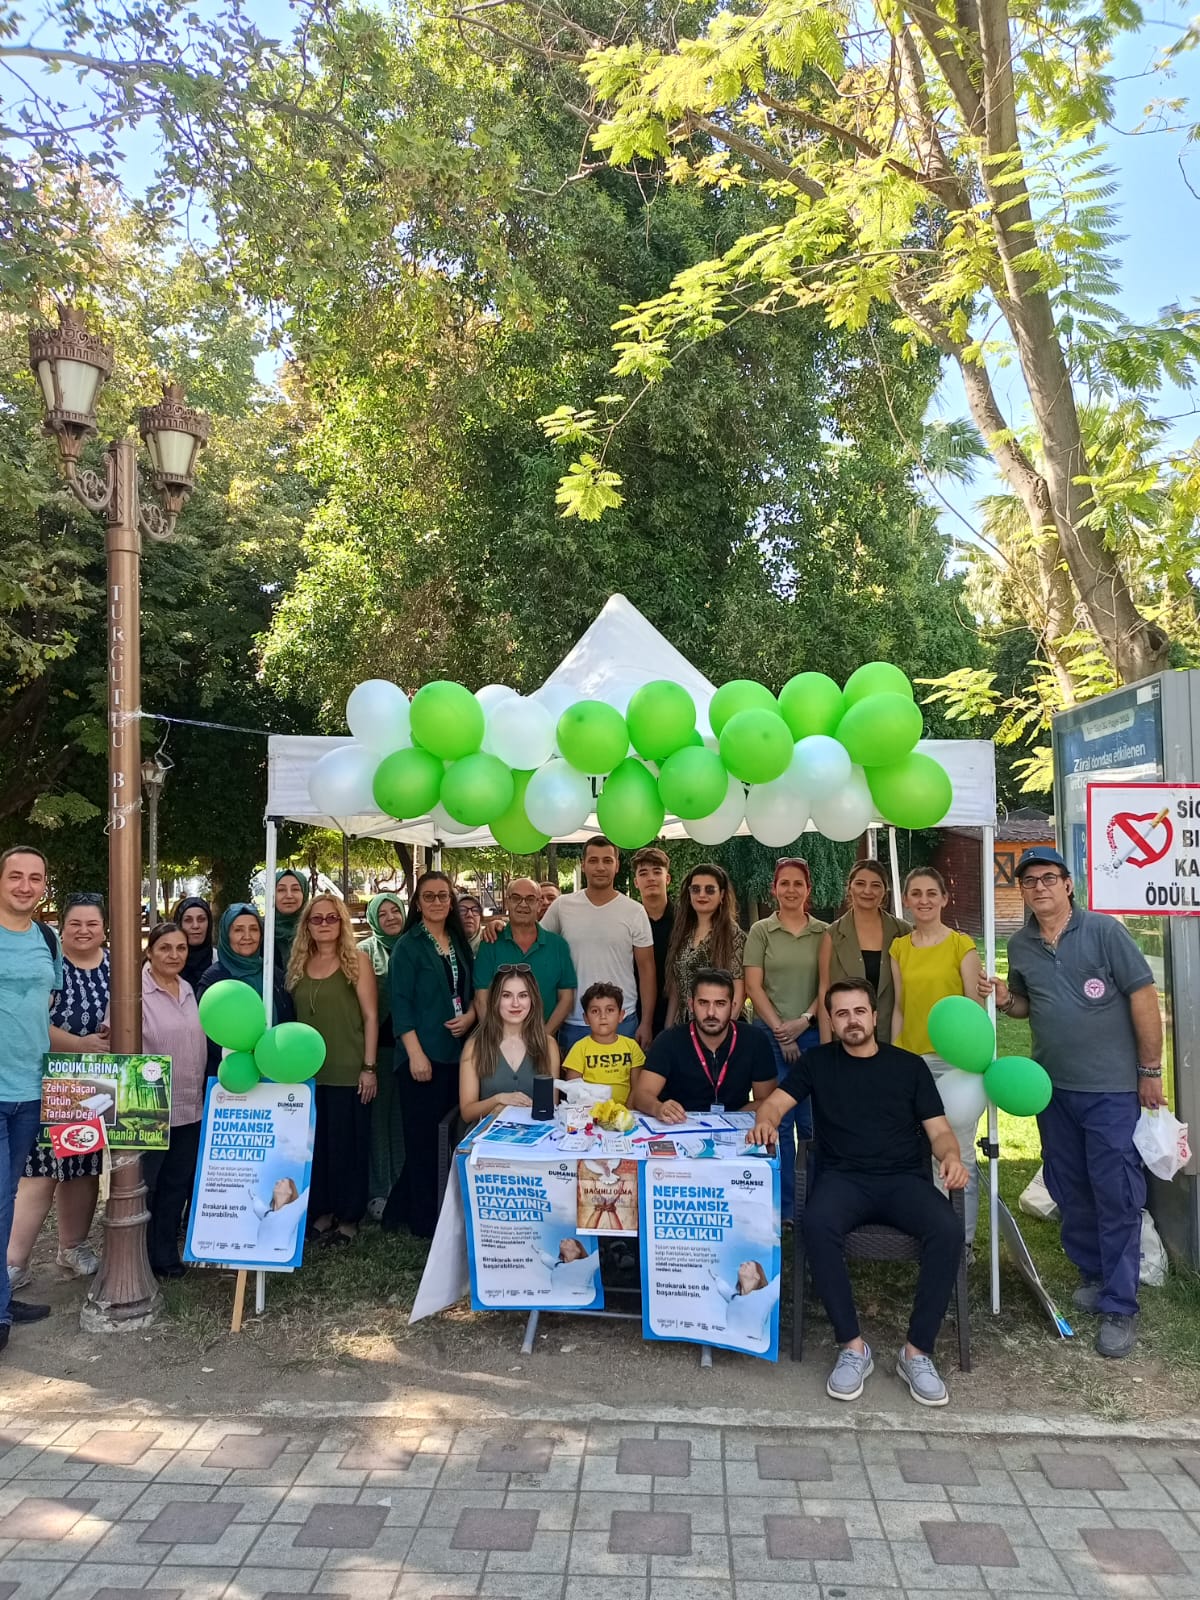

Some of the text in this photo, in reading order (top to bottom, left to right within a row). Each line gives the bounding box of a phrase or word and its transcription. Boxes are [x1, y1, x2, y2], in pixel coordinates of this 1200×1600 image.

[585, 1053, 632, 1068] USPA
[46, 1083, 96, 1095] Zehir Saçan
[46, 1095, 72, 1106] Tütün
[212, 1121, 274, 1133] DUMANSIZ
[108, 1130, 137, 1141] manlar
[212, 1134, 274, 1147] HAYATINIZ
[548, 1170, 577, 1178] DUMANSI
[730, 1179, 764, 1187] DUMANSIZ
[475, 1185, 548, 1200] DUMANSIZ
[479, 1196, 550, 1212] HAYATINIZ
[653, 1199, 729, 1213] DUMANSIZ
[654, 1212, 731, 1227] HAYATINIZ
